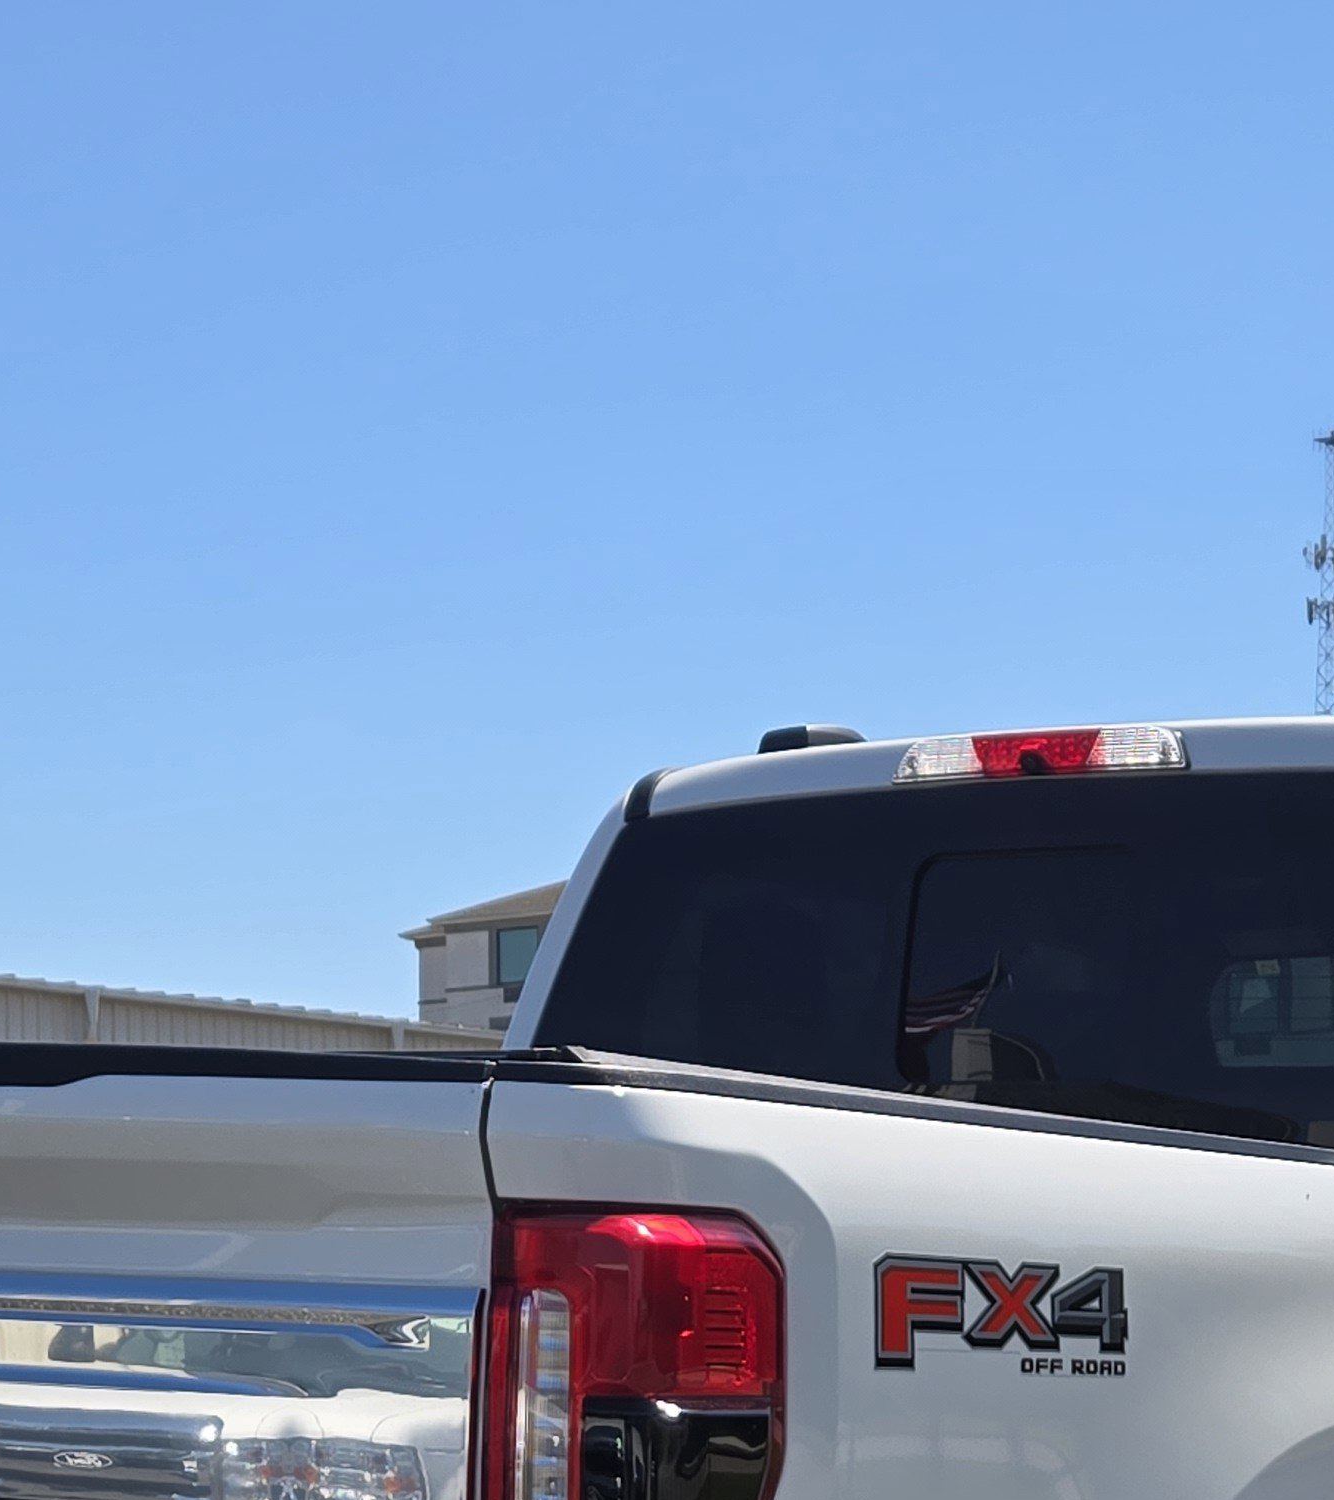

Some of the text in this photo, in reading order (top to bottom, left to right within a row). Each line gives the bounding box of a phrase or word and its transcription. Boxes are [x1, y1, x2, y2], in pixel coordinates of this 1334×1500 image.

[873, 1251, 1128, 1371] FX4
[1020, 1357, 1127, 1377] OFF ROAD
